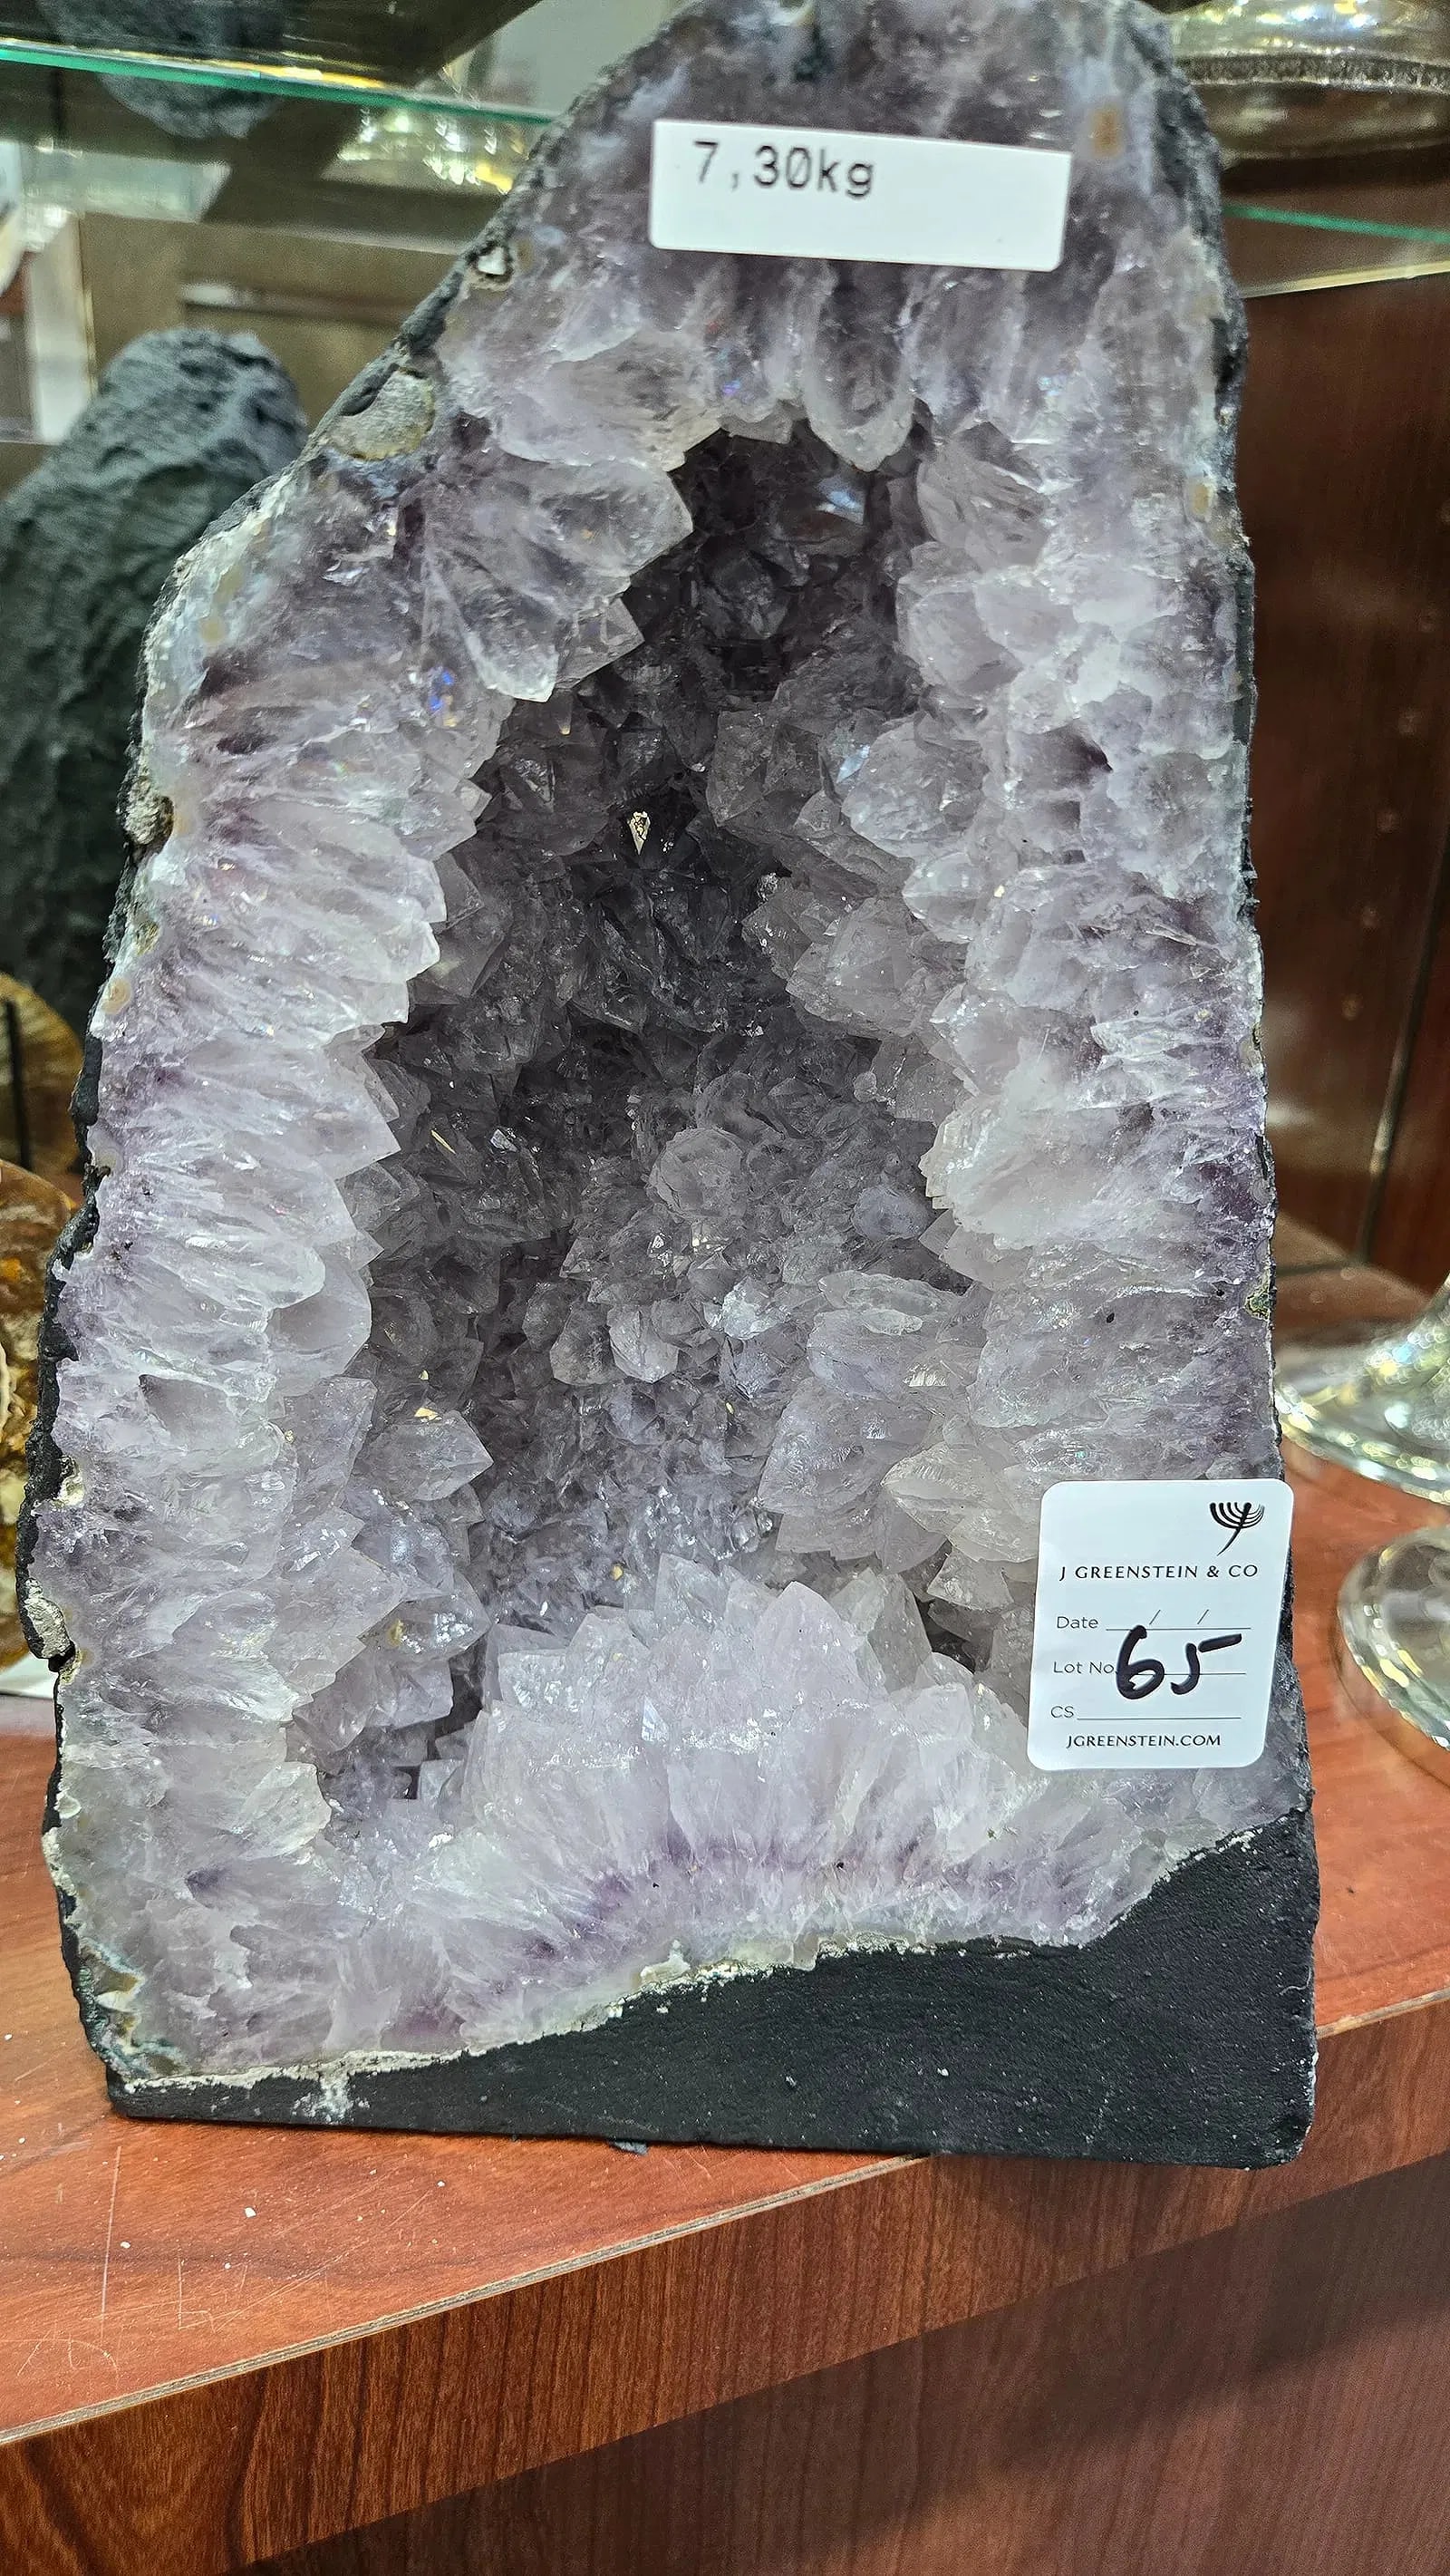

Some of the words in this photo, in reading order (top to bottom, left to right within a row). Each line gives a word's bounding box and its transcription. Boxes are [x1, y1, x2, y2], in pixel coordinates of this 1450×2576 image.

[692, 140, 875, 199] 7,30kg
[1058, 1566, 1067, 1581] J
[1075, 1564, 1198, 1579] GREENSTEIN
[1207, 1565, 1220, 1578] &
[1228, 1564, 1258, 1577] CO
[1056, 1616, 1099, 1629] Date
[1053, 1661, 1083, 1674] Lot
[1116, 1624, 1242, 1700] 65
[1050, 1705, 1075, 1719] CS
[1065, 1734, 1222, 1748] JGREENSTEIN.COM
